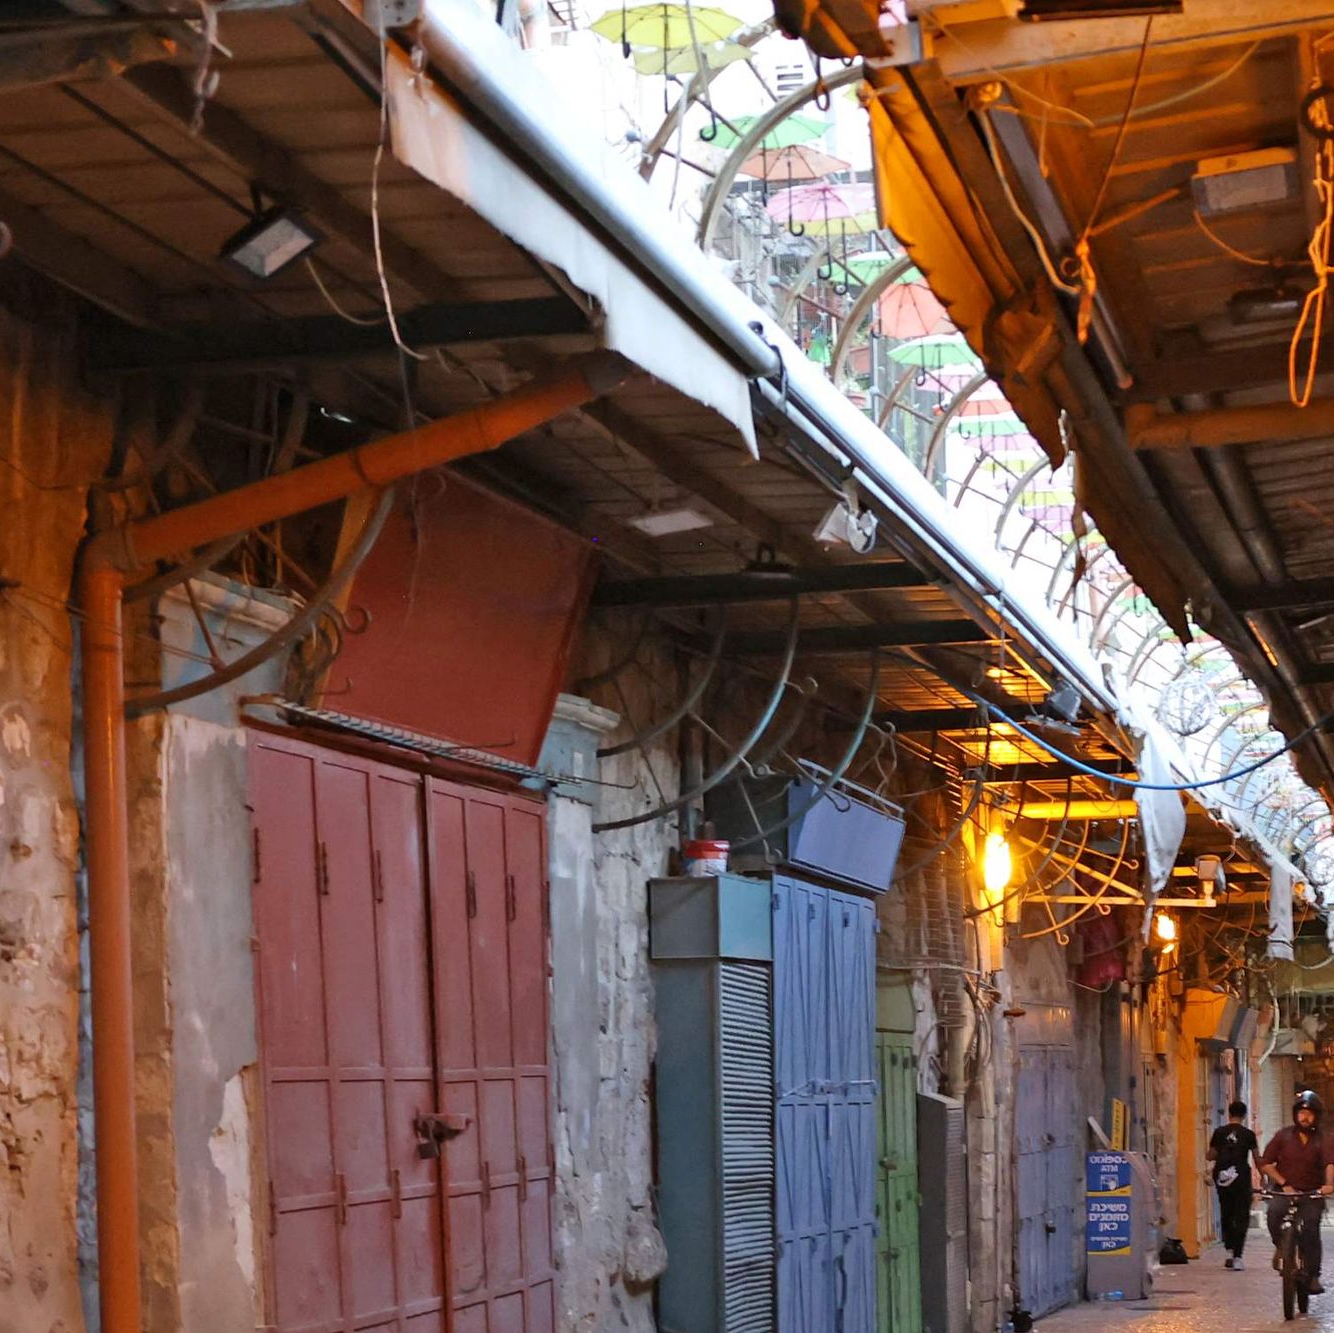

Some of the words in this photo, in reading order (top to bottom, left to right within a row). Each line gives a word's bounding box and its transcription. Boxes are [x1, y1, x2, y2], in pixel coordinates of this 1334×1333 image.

[1091, 1203, 1127, 1212] משיכת
[1089, 1213, 1129, 1221] מזומנים
[1099, 1222, 1118, 1232] כאן
